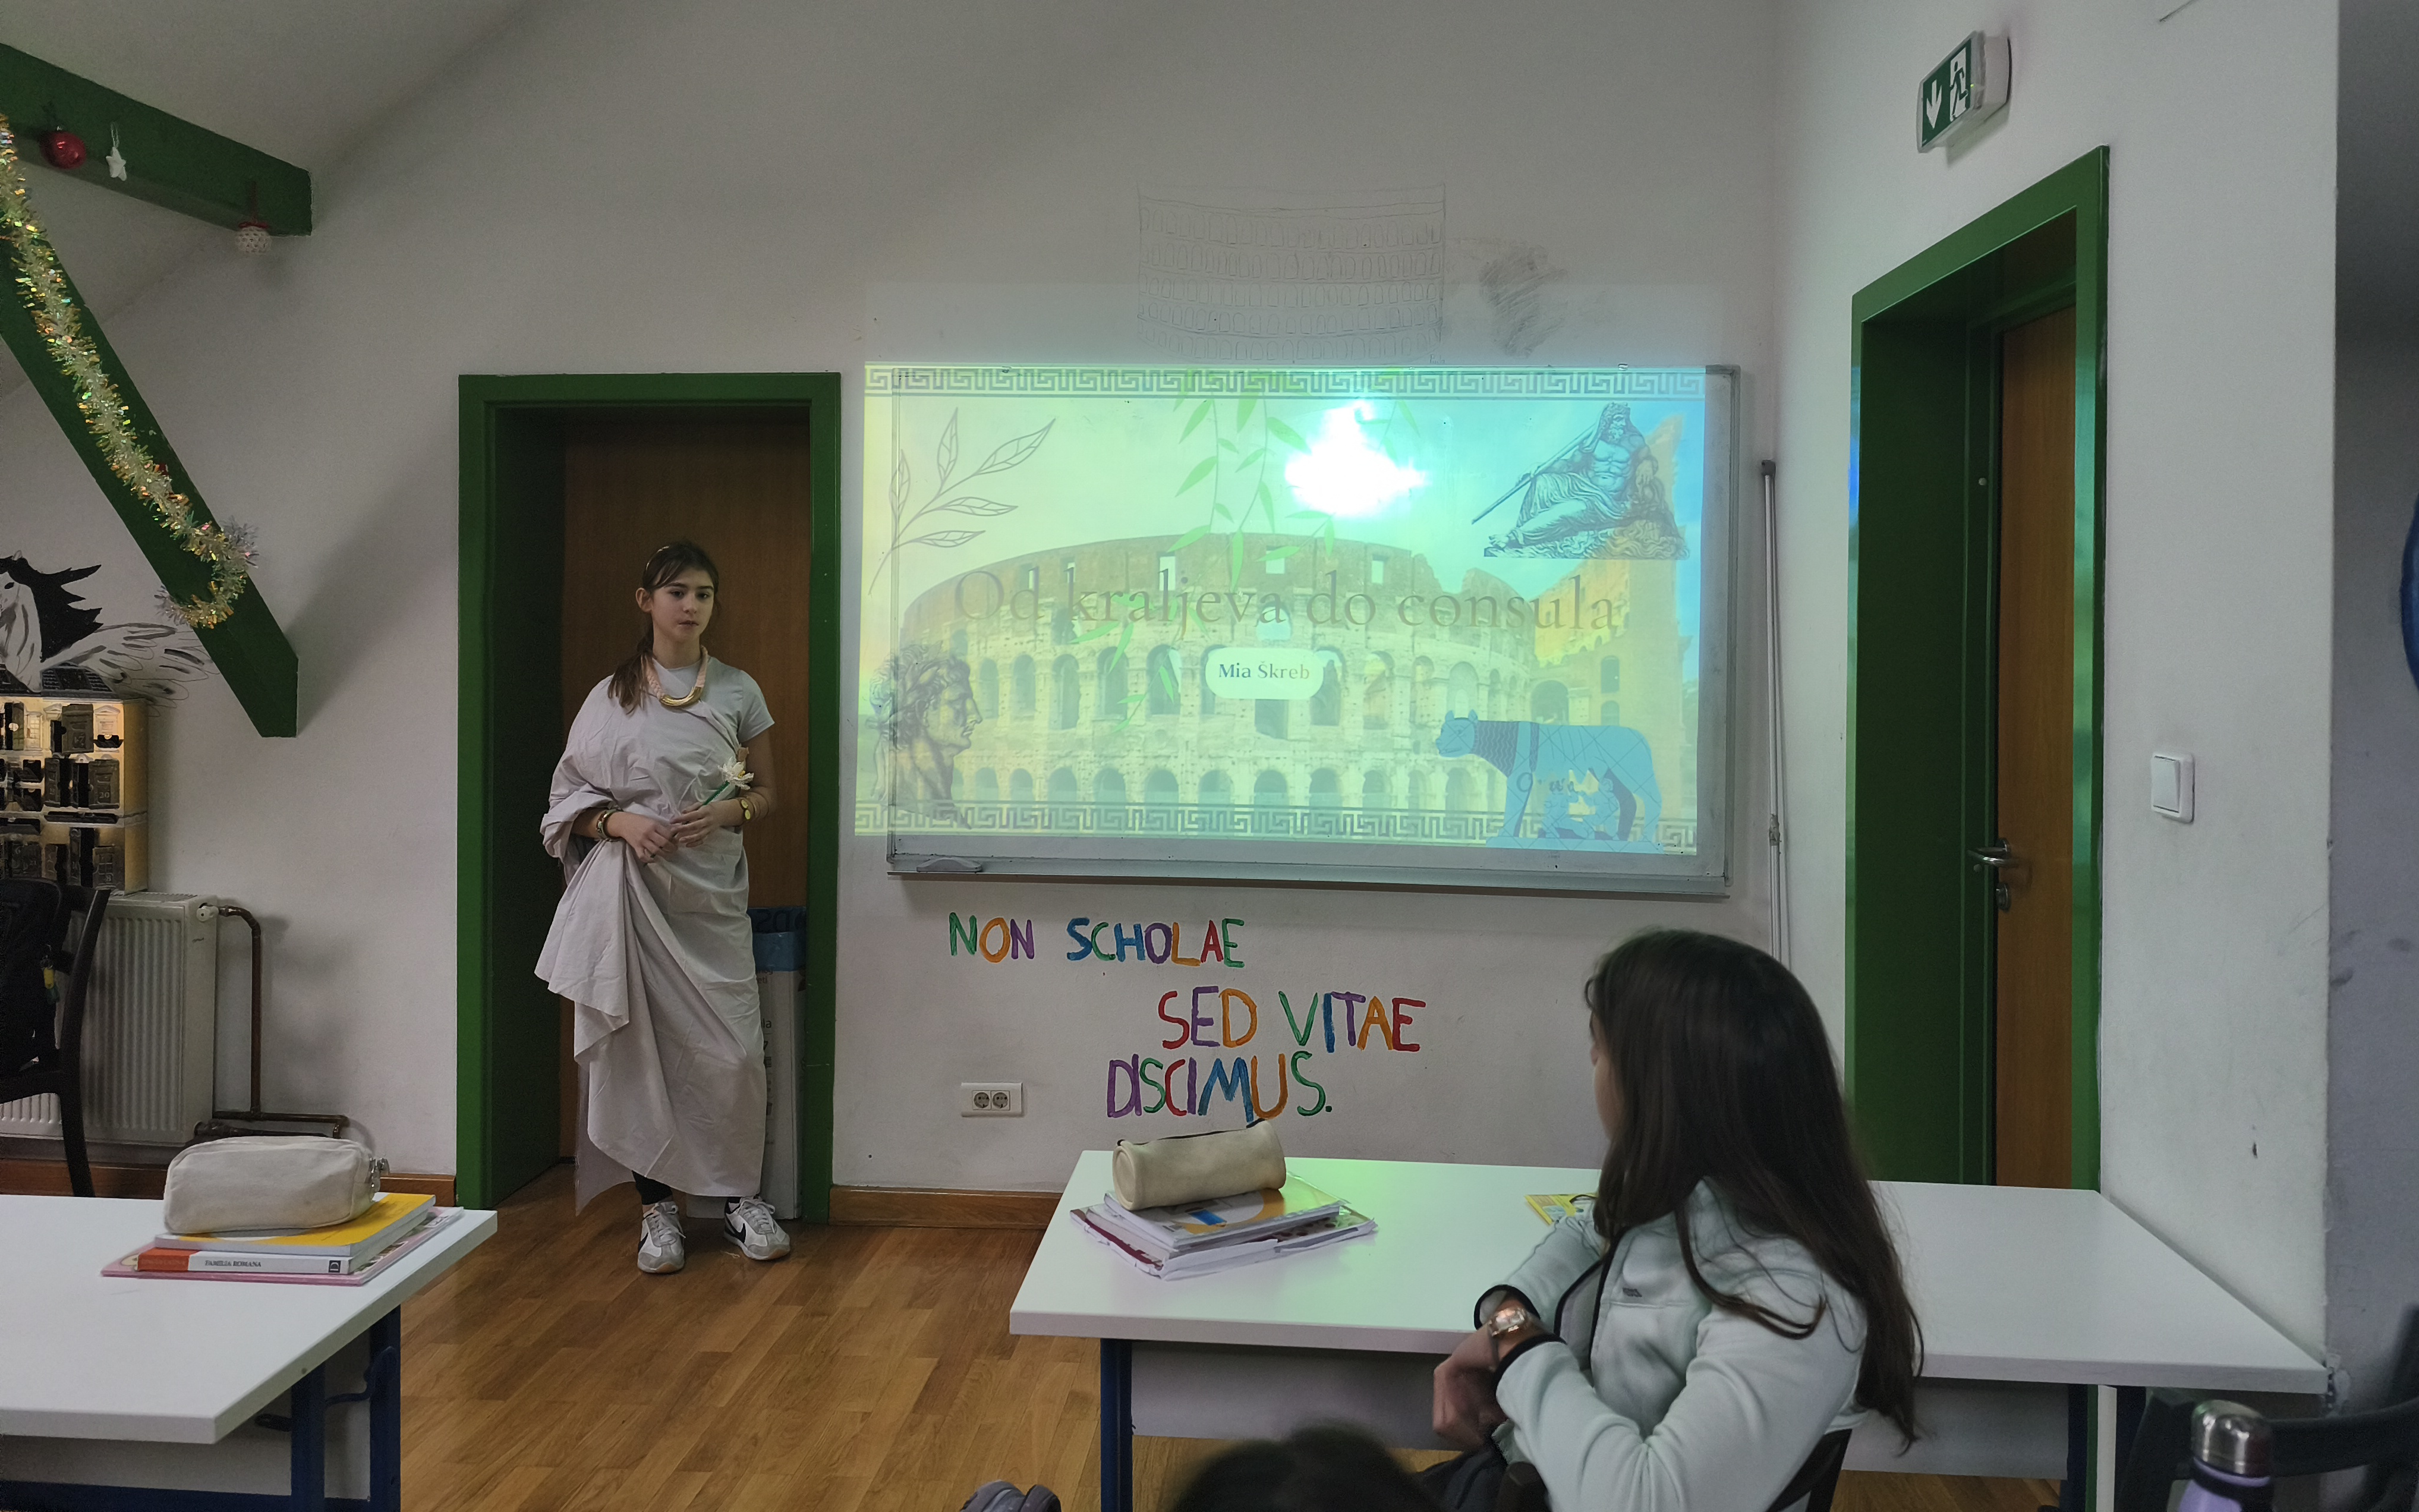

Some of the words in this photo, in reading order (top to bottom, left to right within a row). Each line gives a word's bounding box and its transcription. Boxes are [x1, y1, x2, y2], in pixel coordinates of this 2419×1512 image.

[955, 566, 1045, 621] Od
[1064, 566, 1287, 641] kraljeva
[1308, 569, 1377, 626] do
[1398, 574, 1618, 631] consula
[1218, 662, 1251, 678] Mia
[1257, 661, 1310, 679] Škreb
[949, 912, 1035, 964] NON
[1066, 917, 1245, 968] SCHOLAE
[1158, 986, 1258, 1049] SED
[1278, 991, 1426, 1053] VITAE
[1107, 1050, 1333, 1122] DISCIMUS.
